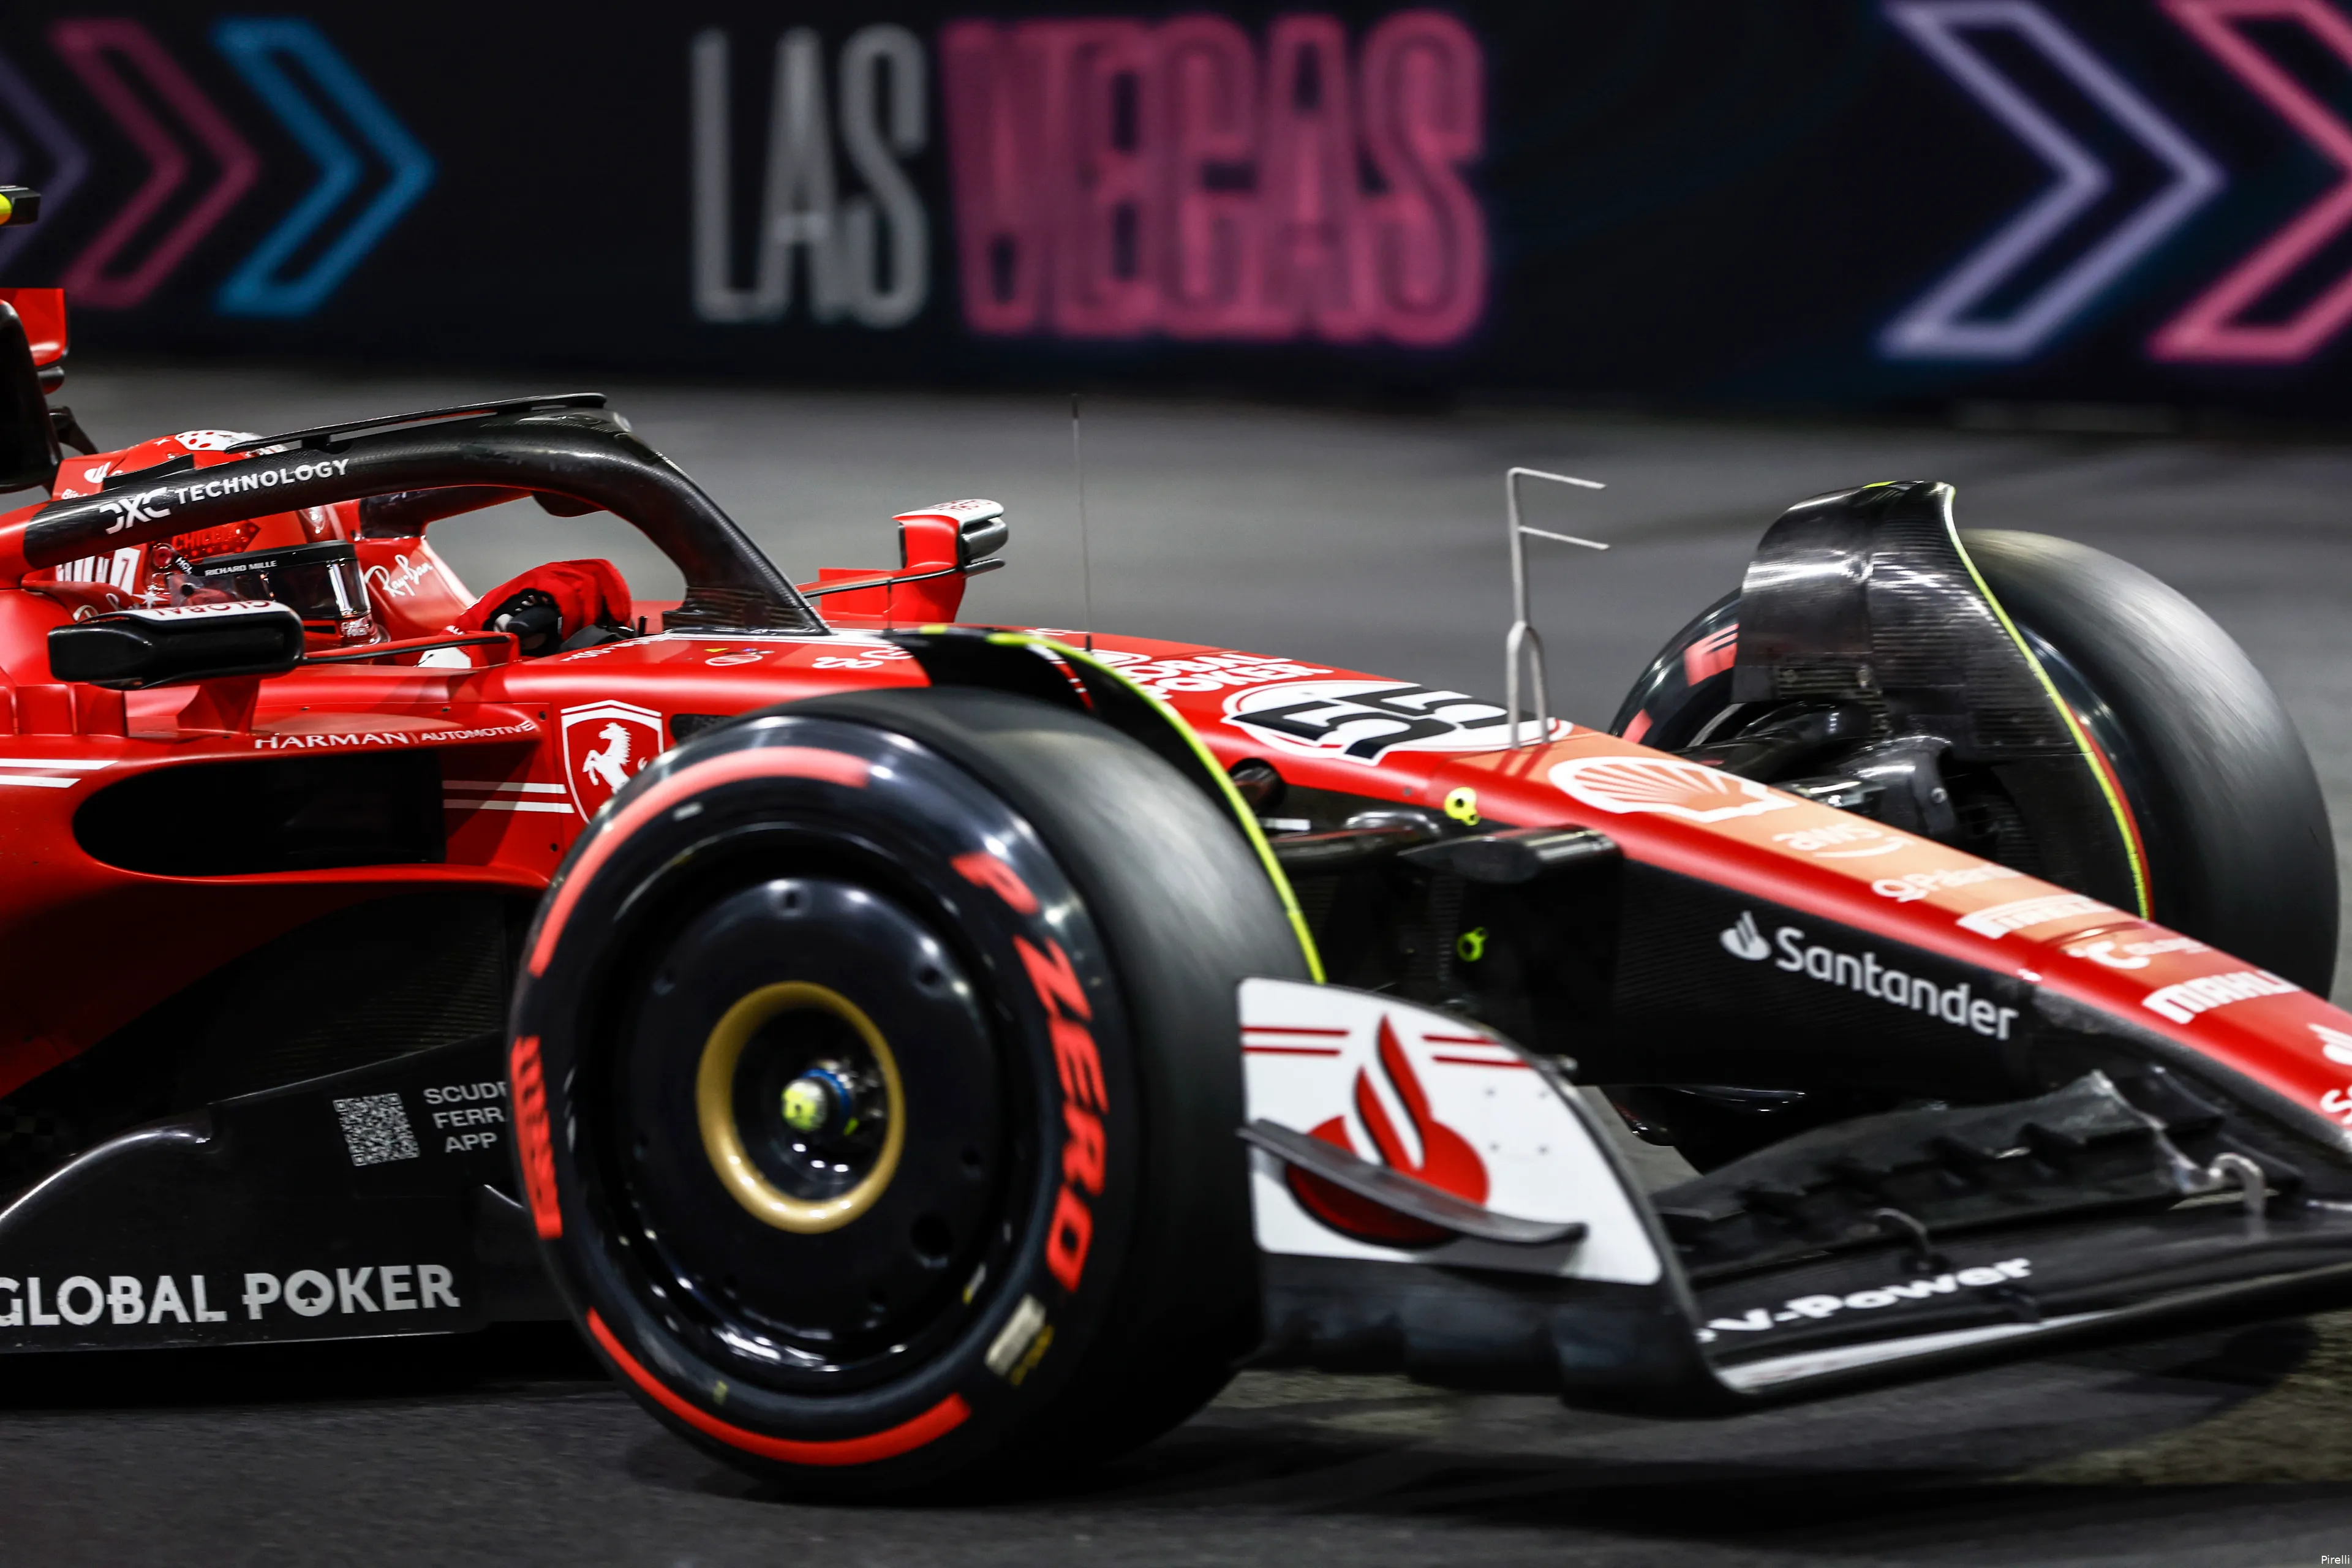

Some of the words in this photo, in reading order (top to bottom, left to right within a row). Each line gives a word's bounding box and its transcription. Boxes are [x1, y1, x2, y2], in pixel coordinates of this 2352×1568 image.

[690, 27, 929, 326] LAS
[941, 11, 1490, 346] VEGAS
[99, 487, 171, 535] DXC
[175, 458, 350, 505] TECHNOLOGY
[205, 565, 247, 576] RICHARD
[248, 560, 277, 570] MILLE
[255, 732, 410, 748] HARMAN
[421, 719, 538, 741] AUTOMOTIVE
[1230, 685, 1540, 760] 55
[1775, 926, 2019, 1040] Santander
[432, 1106, 505, 1129] FERR
[445, 1131, 497, 1153] APP
[1012, 934, 1109, 1292] ZERO
[0, 1273, 227, 1327] GLOBAL
[241, 1264, 461, 1321] POKER
[1708, 1257, 2032, 1332] V-Power
